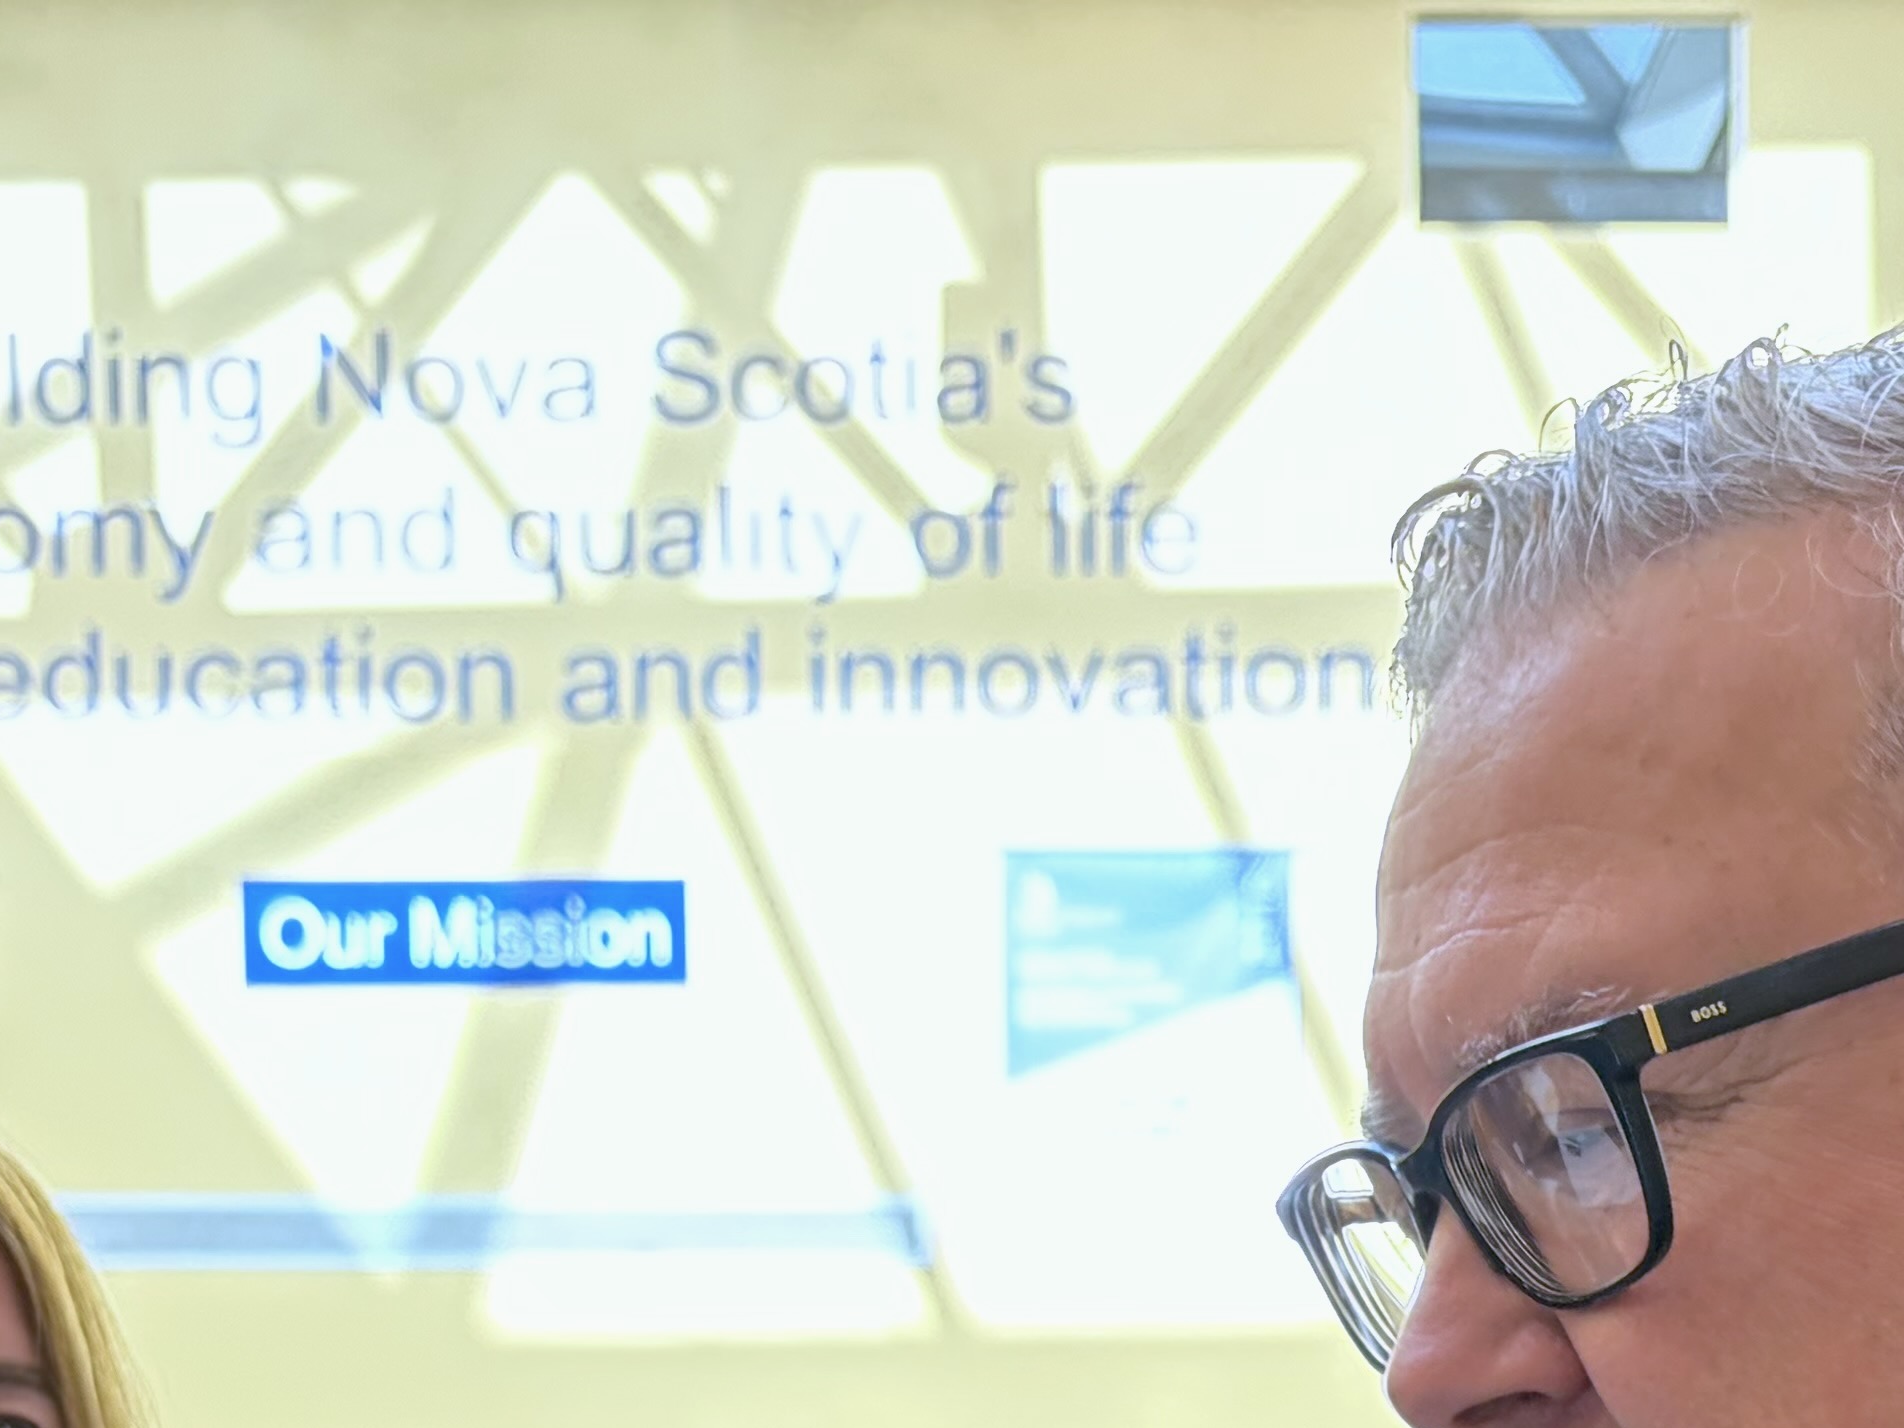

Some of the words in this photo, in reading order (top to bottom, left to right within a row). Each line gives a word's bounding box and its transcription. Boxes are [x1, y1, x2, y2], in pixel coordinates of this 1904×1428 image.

[313, 328, 596, 425] Nova
[650, 328, 1075, 426] Scotia's
[253, 485, 457, 573] and
[507, 482, 863, 605] quality
[911, 479, 1019, 580] of
[1048, 479, 1198, 580] life
[560, 624, 764, 724] and
[806, 622, 1376, 724] innovation
[258, 894, 399, 971] Our
[407, 892, 674, 970] Mission
[1690, 1000, 1728, 1023] BOSS
